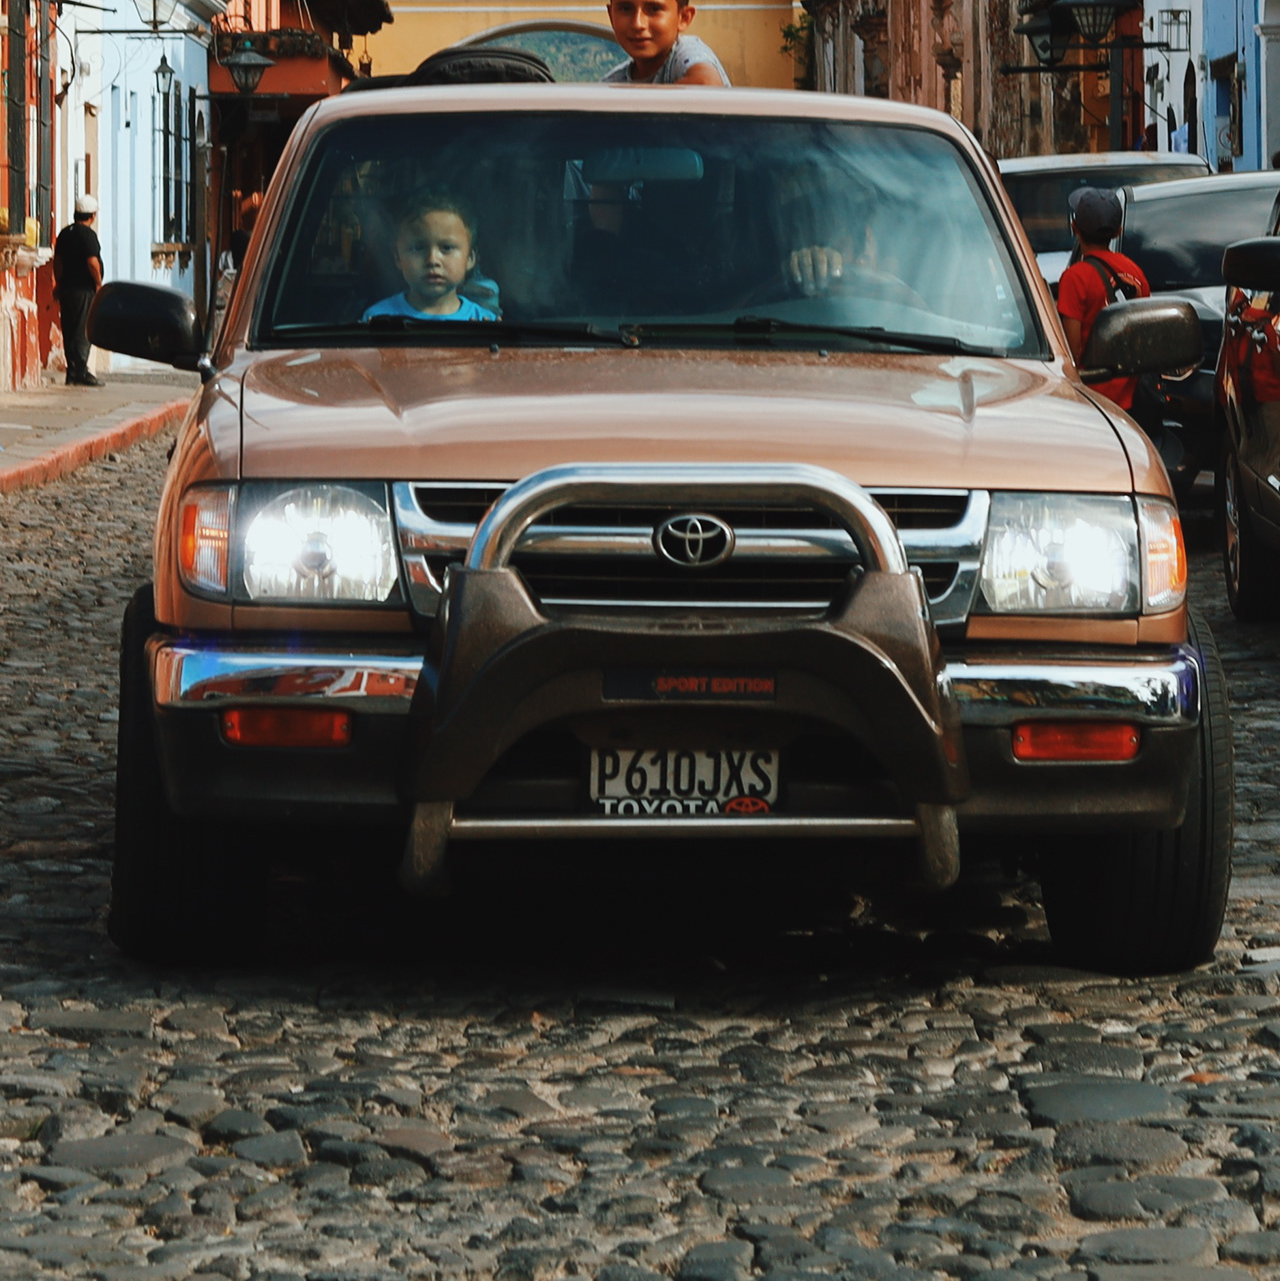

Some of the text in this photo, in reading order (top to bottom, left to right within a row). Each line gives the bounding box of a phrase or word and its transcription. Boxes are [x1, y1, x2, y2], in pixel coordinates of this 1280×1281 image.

[655, 676, 775, 694] SPORT EDITION
[598, 750, 773, 797] P610JXS
[598, 799, 721, 815] TOYOTA
